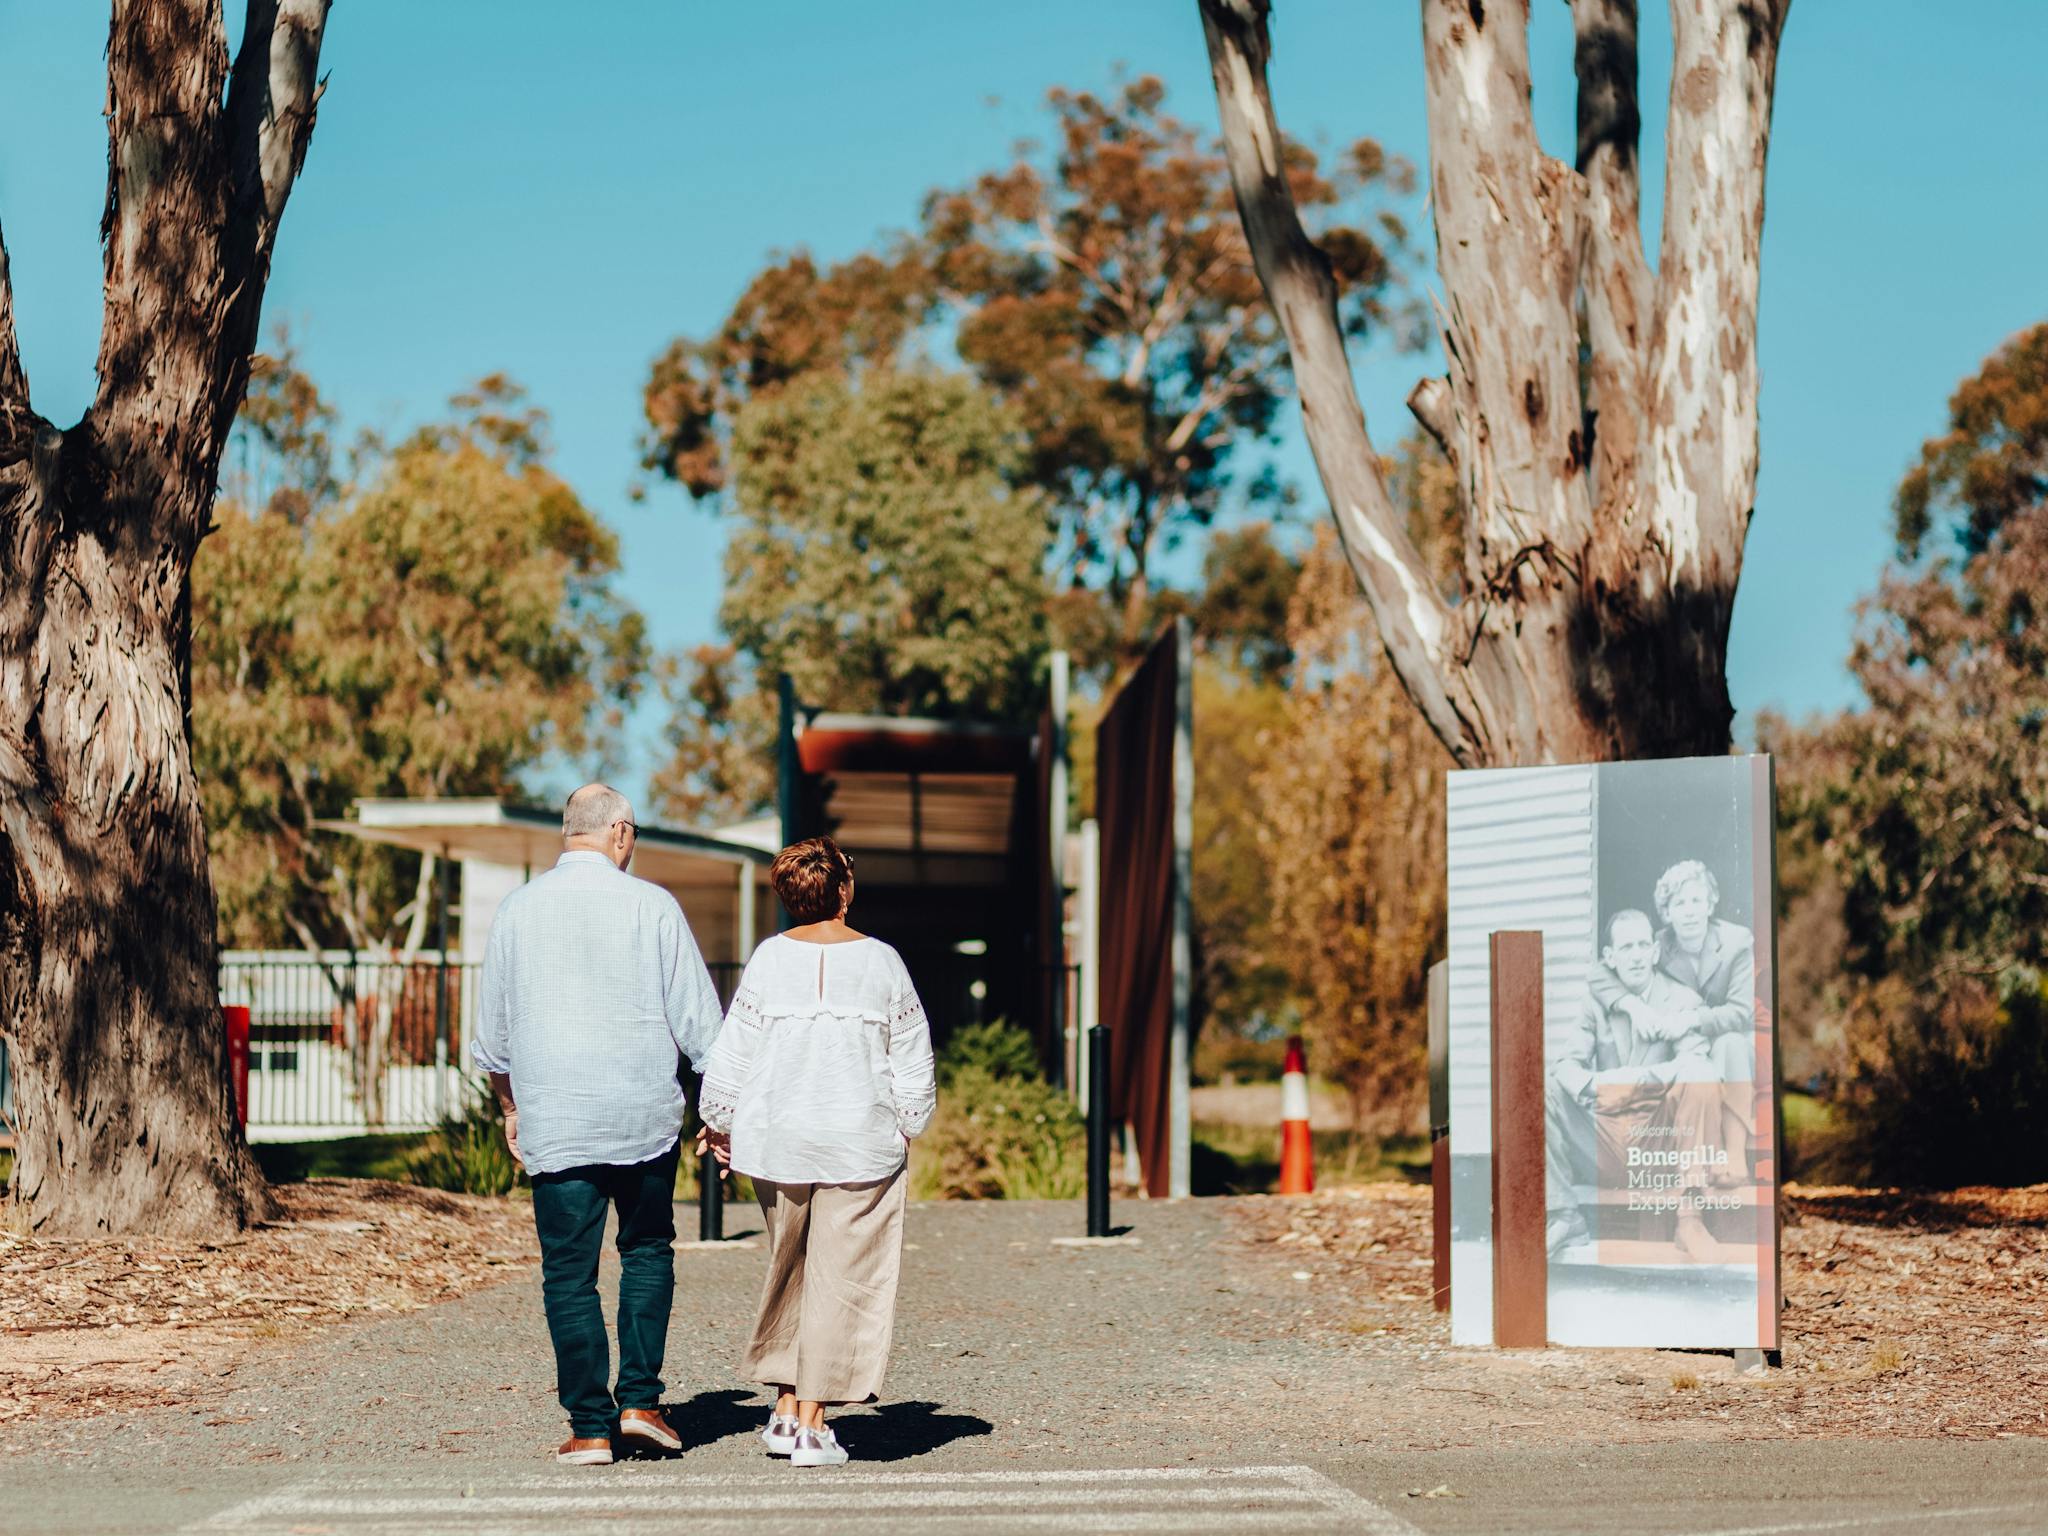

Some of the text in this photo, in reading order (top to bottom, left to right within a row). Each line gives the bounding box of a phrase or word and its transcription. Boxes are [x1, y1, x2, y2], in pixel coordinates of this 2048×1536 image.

[1629, 1124, 1695, 1137] Welcome to
[1627, 1145, 1728, 1169] Bonegilla
[1627, 1170, 1708, 1192] Migrant
[1628, 1191, 1741, 1215] Experience
